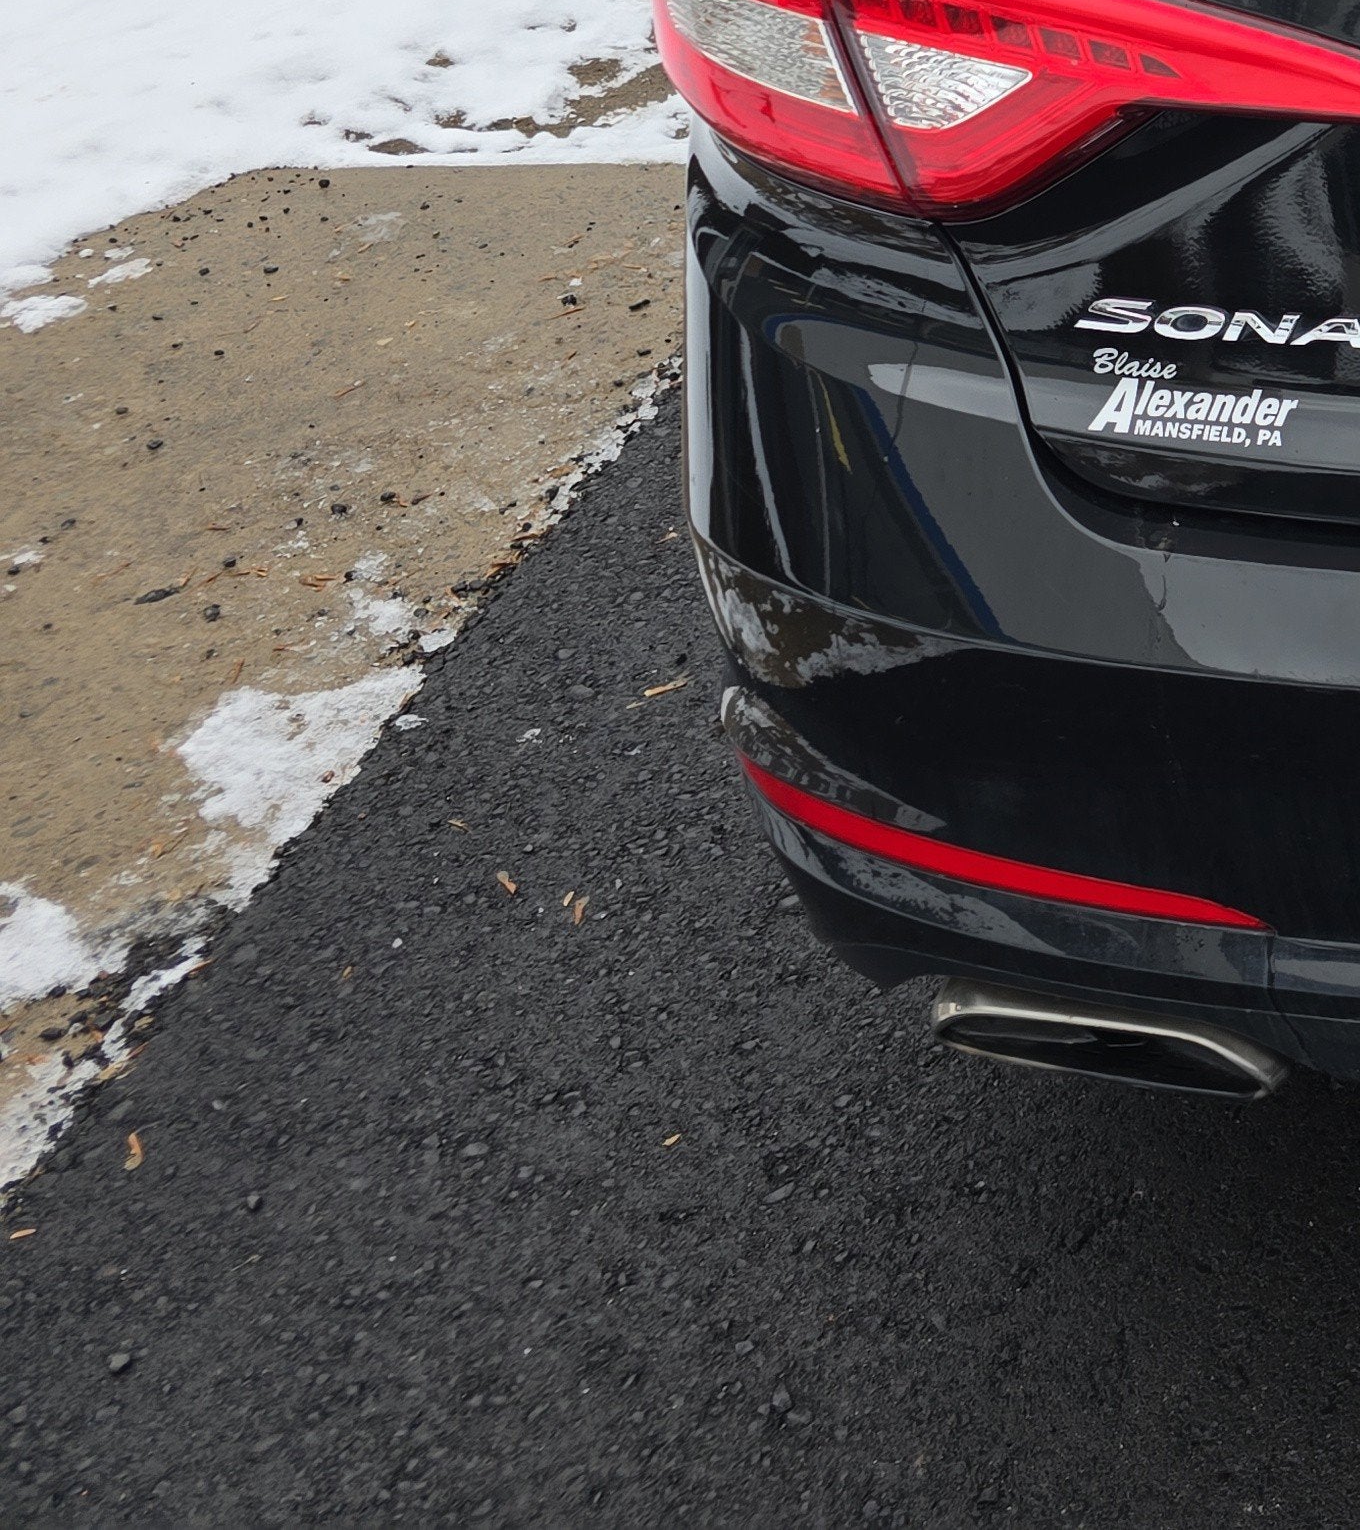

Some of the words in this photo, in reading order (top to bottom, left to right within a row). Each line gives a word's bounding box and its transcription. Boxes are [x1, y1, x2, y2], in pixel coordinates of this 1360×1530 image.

[1092, 347, 1178, 380] Blaise
[1088, 376, 1299, 434] Alexander
[1133, 419, 1251, 448] MANSFIELD,
[1257, 429, 1283, 448] PA
